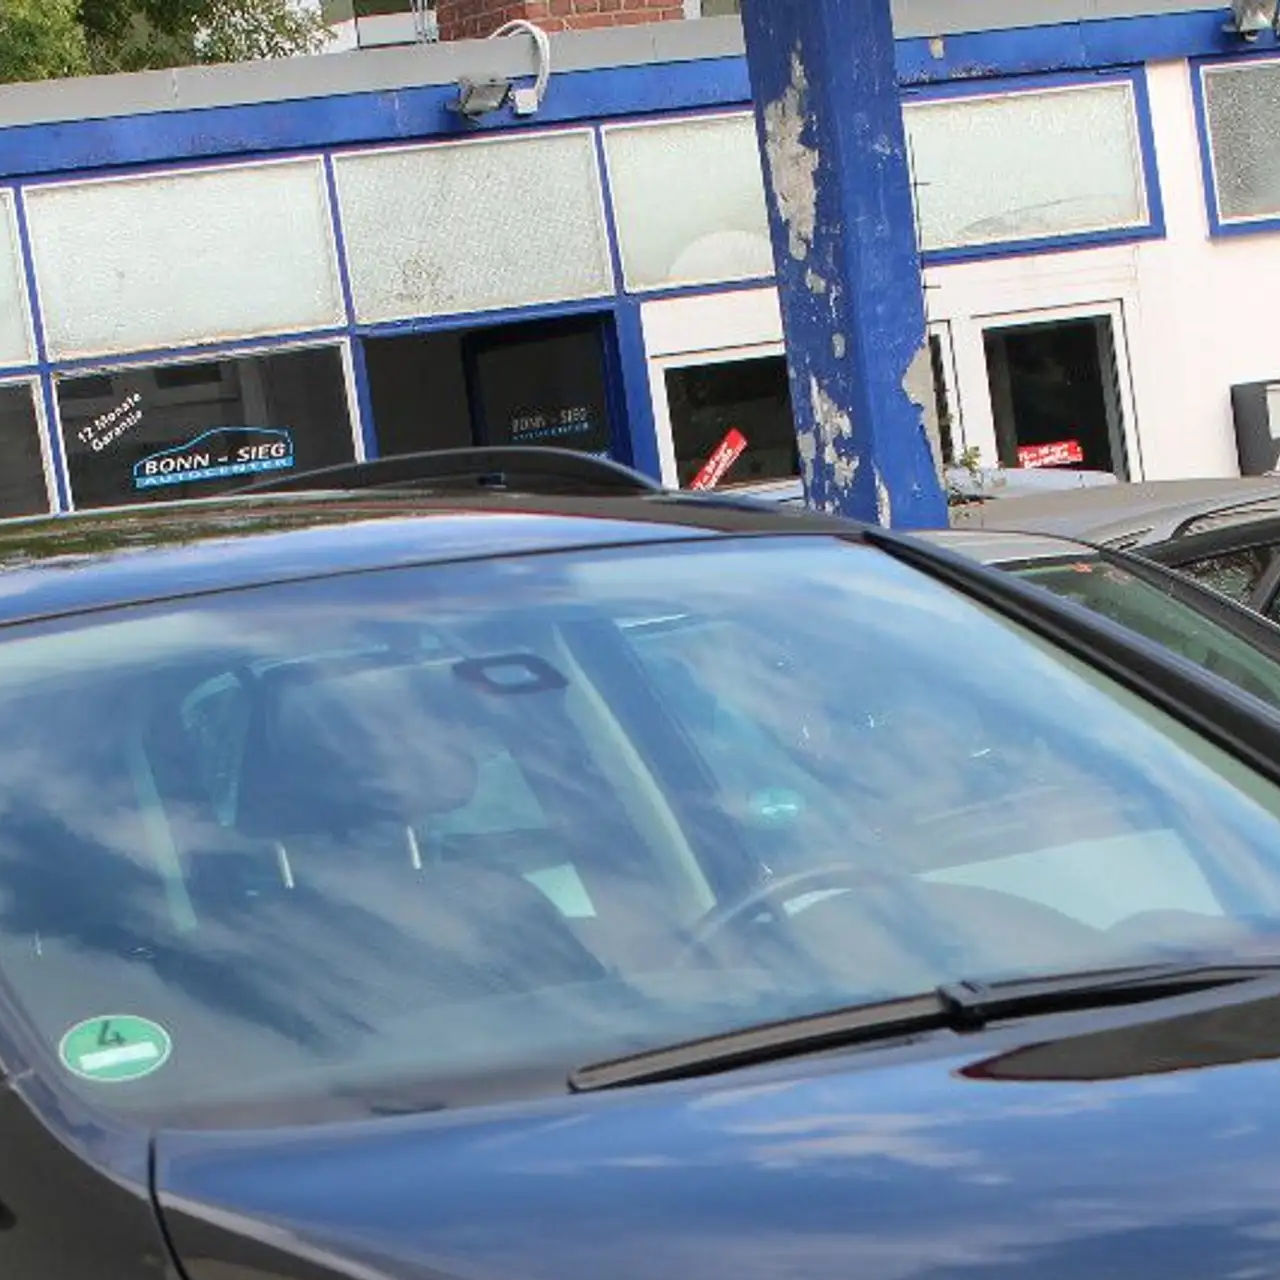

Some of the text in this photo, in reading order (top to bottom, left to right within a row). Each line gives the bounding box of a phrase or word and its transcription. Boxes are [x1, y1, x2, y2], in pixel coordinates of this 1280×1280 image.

[94, 392, 142, 431] Monate
[91, 408, 143, 451] Garantie
[143, 459, 290, 485] AUTOCENTER
[144, 453, 210, 475] BONN
[236, 443, 287, 462] SIEG
[98, 1019, 127, 1046] 4
